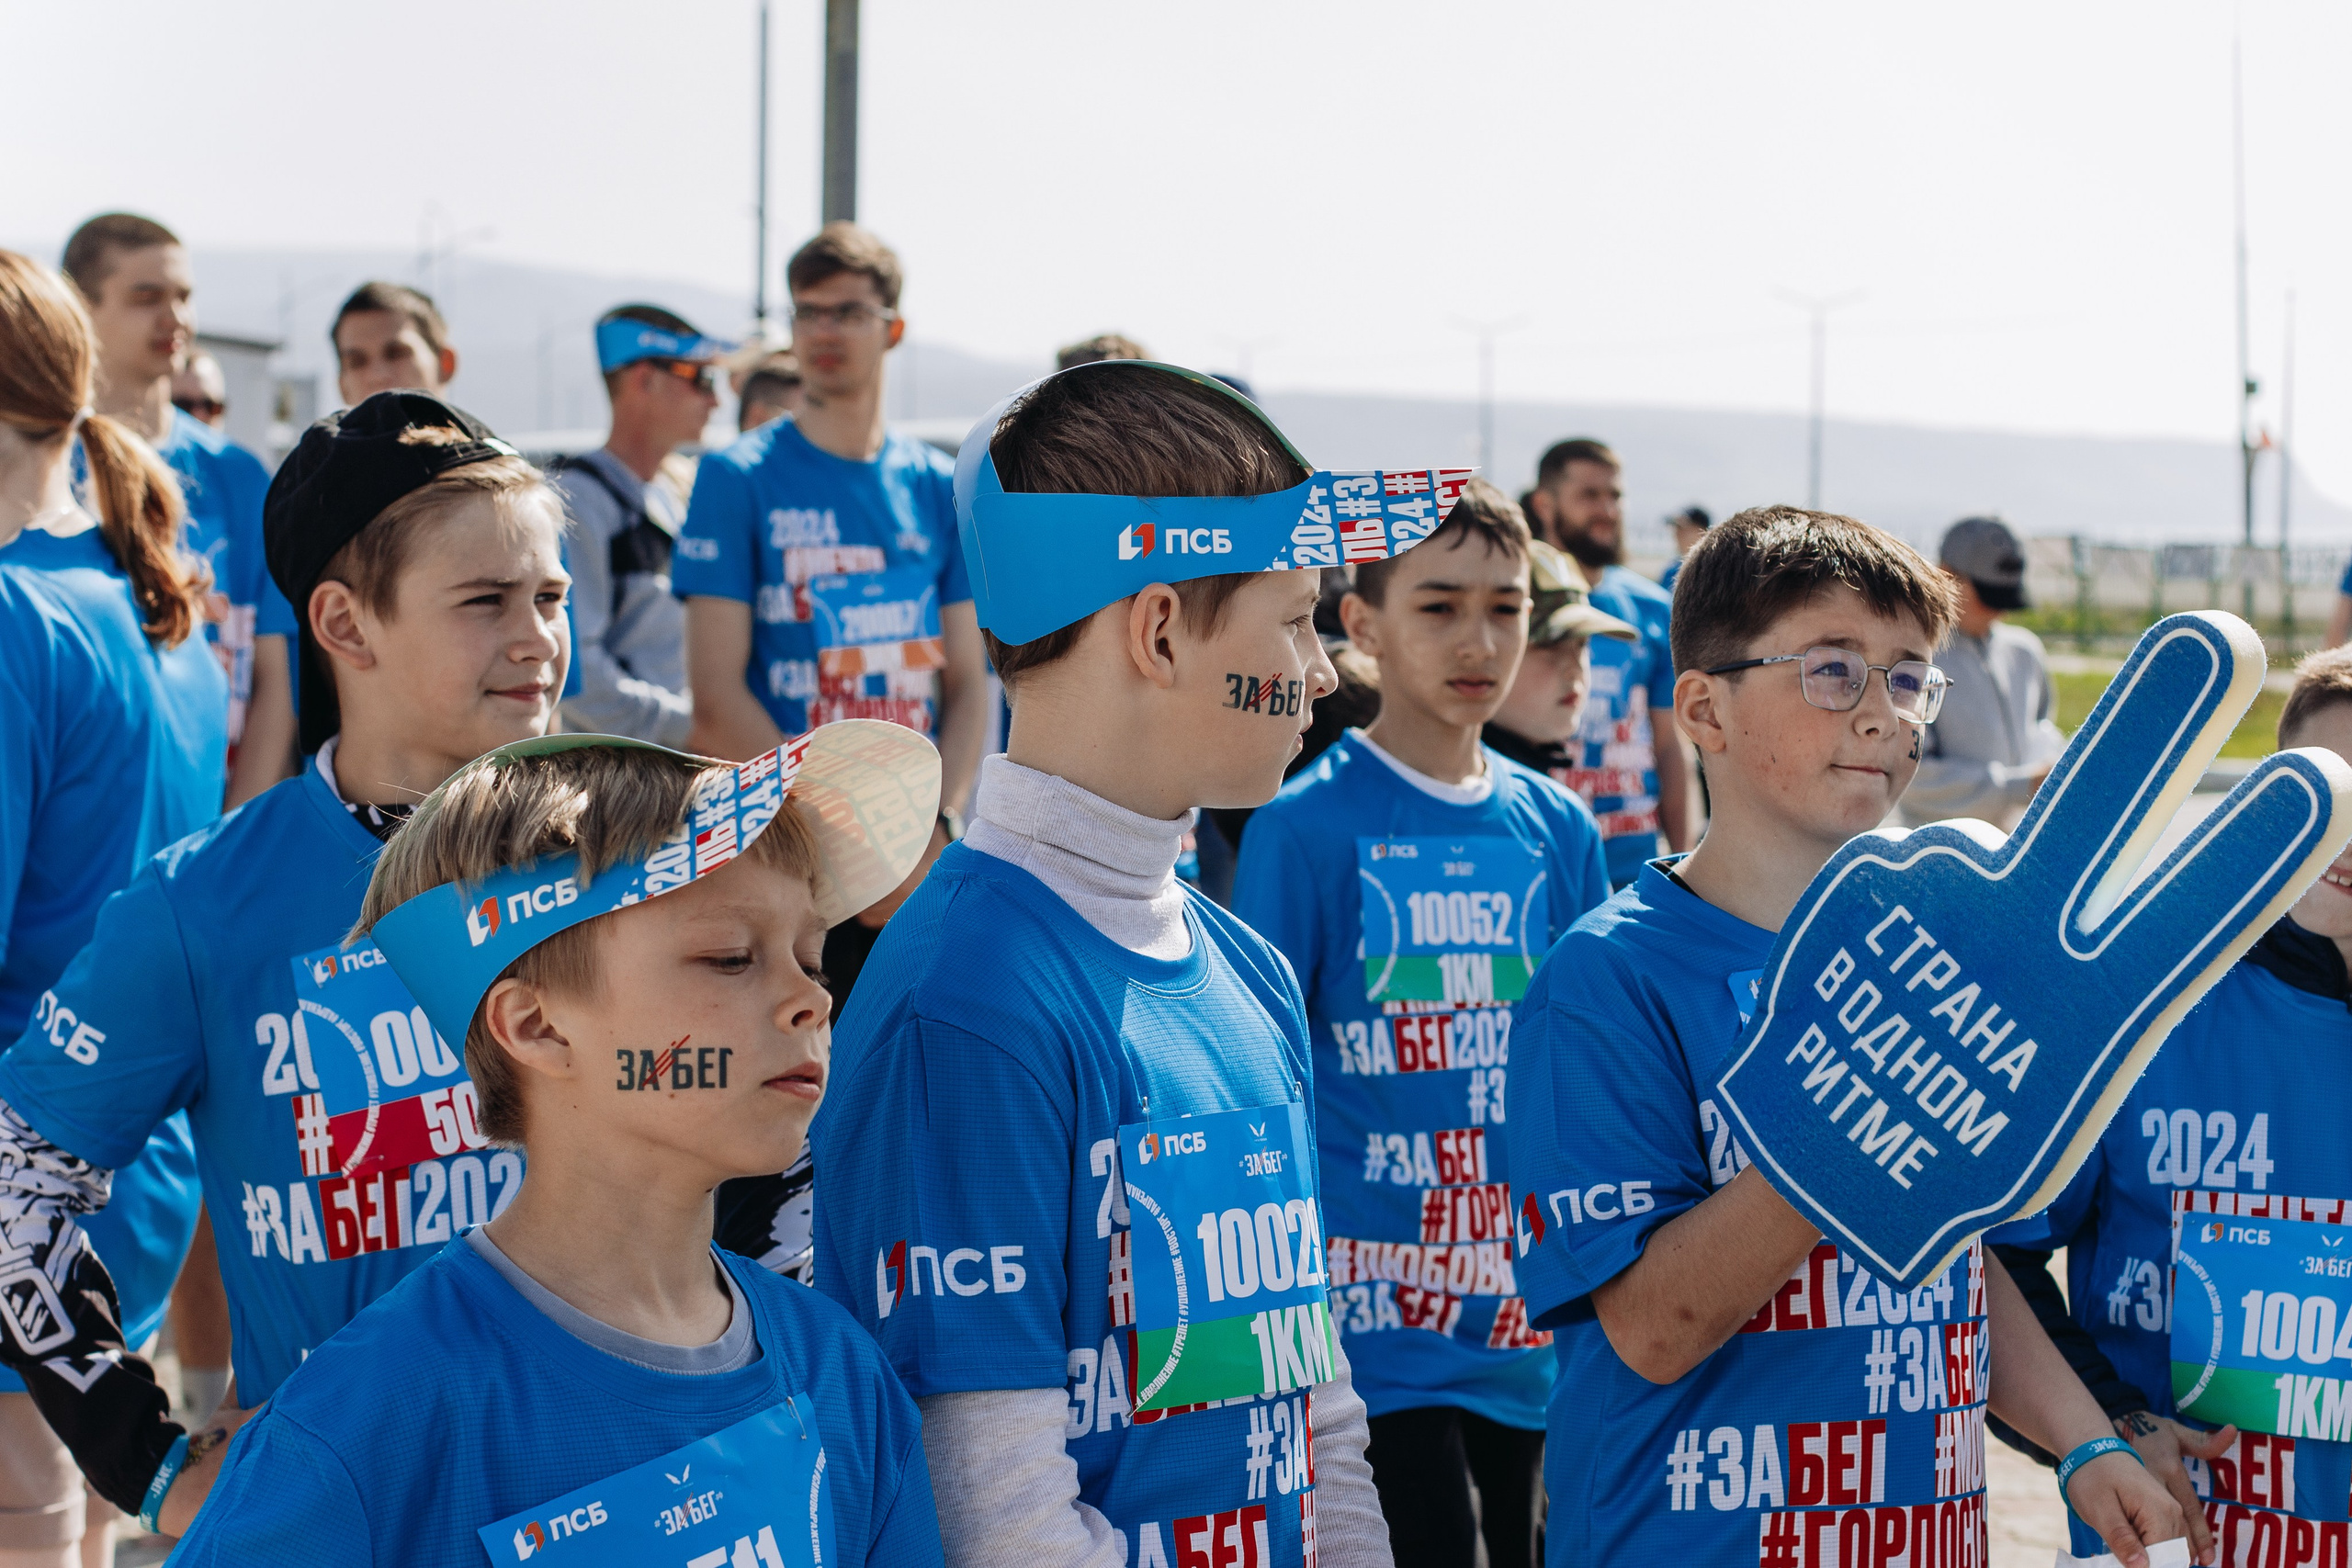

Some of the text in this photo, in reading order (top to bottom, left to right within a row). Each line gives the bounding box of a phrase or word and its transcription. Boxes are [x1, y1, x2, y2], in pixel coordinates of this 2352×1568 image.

[1329, 470, 1382, 516] #З
[1165, 528, 1233, 554] ПСБ
[507, 877, 578, 924] ПСБ
[1407, 891, 1514, 945] 10052
[1865, 905, 2039, 1093] СТРАНА
[36, 989, 107, 1066] ПСБ
[1814, 946, 2010, 1157] В ОДНОМ
[1785, 1021, 1939, 1190] РИТМЕ
[1164, 1131, 1206, 1156] ПСБ
[1363, 1127, 1488, 1187] #ЗАБЕГ
[2142, 1108, 2275, 1190] 2024
[1549, 1181, 1656, 1229] ПСБ
[1157, 1212, 1181, 1257] #ВОСТОРГ
[2229, 1226, 2271, 1247] ПСБ
[910, 1246, 1027, 1297] ПСБ
[1172, 1256, 1189, 1315] #УДИВЛЕНИЕ
[1170, 1317, 1189, 1358] #ТРЕПЕТ
[1666, 1418, 1887, 1511] #ЗАБЕГ
[551, 1500, 608, 1541] ПСБ
